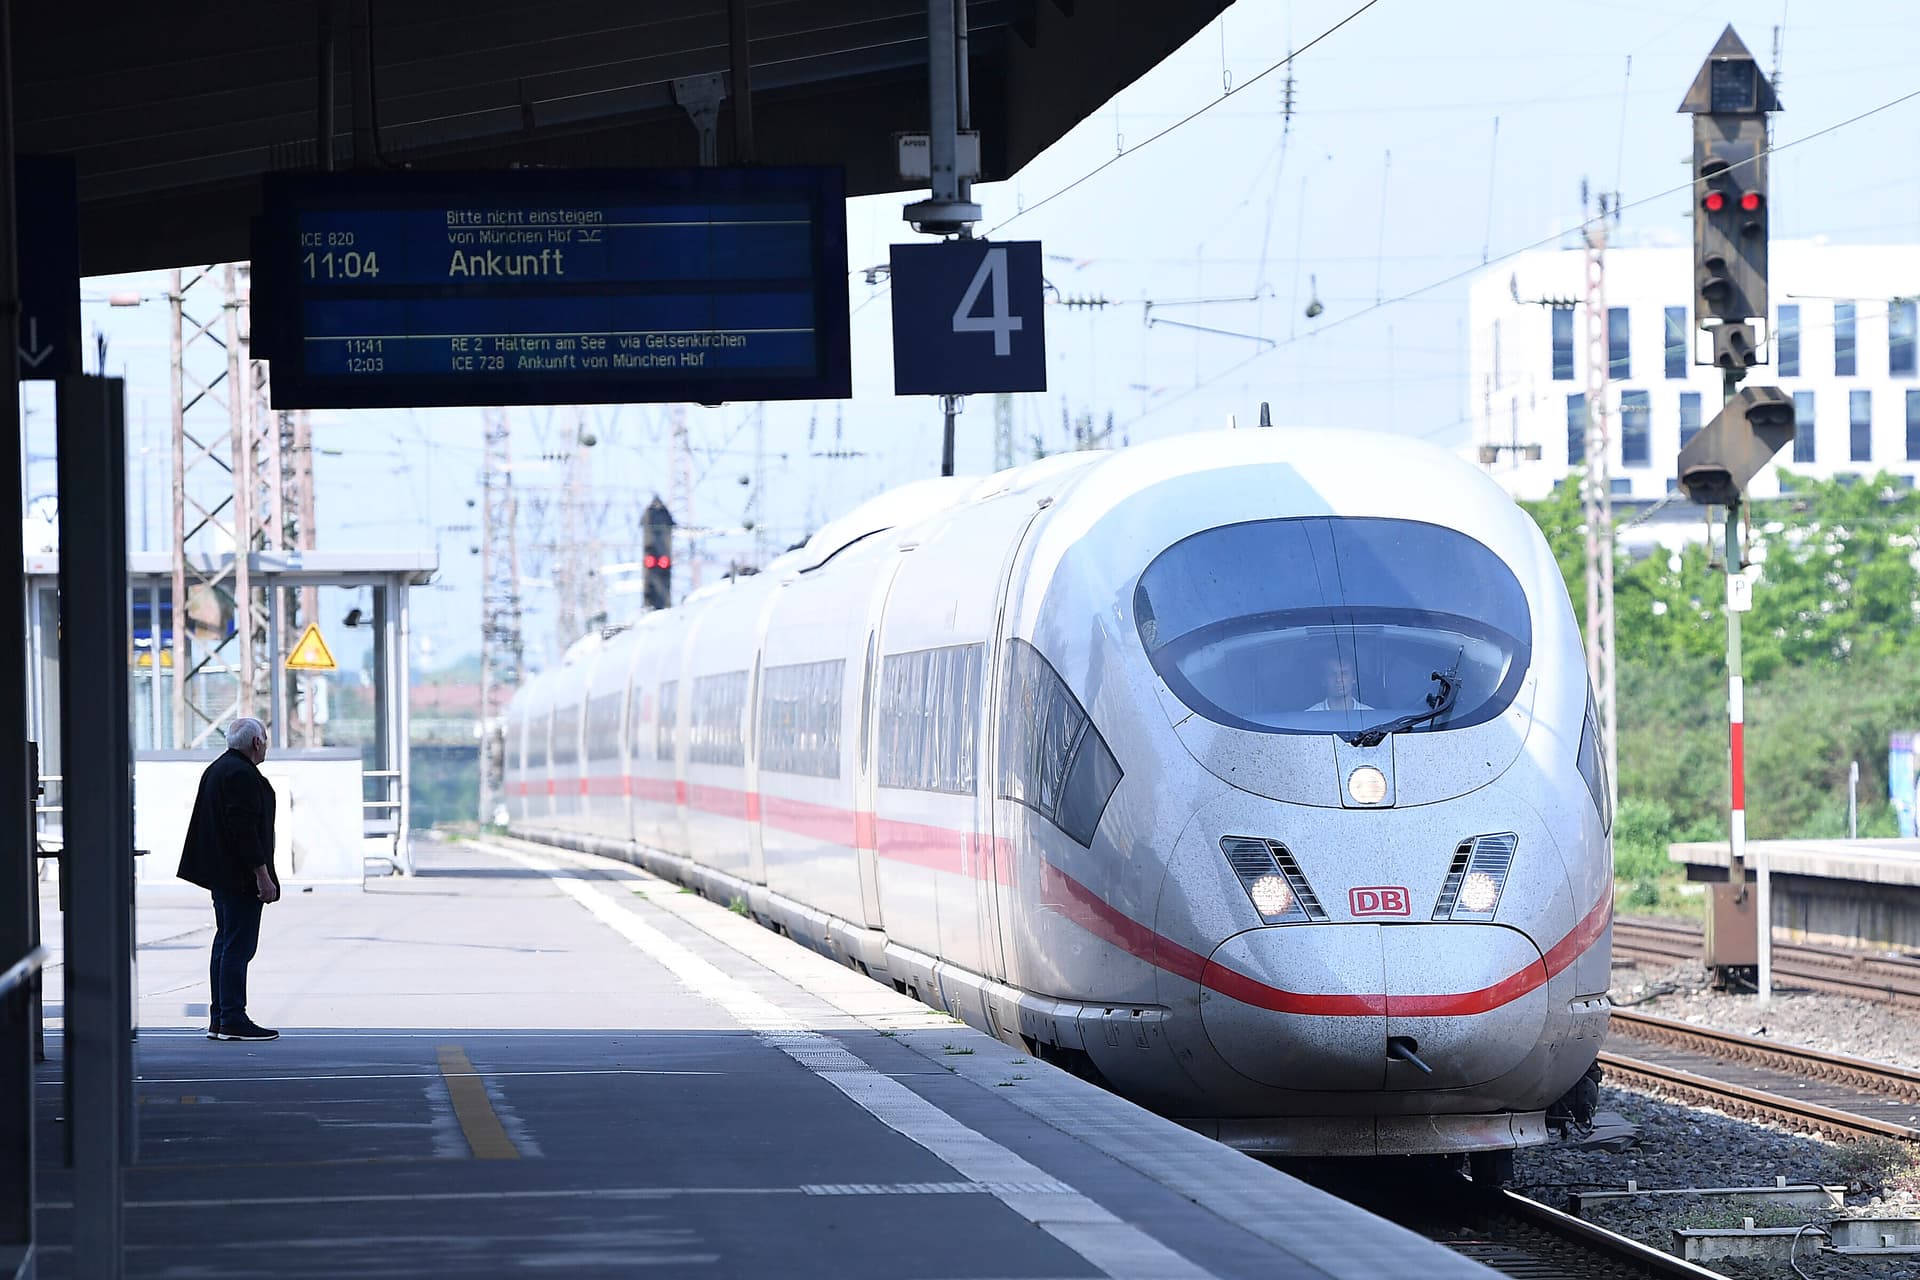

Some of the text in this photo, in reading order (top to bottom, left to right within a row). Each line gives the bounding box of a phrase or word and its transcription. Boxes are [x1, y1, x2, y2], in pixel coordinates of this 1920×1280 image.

[446, 210, 603, 225] Bitte nicht einsteigen
[301, 232, 355, 246] ICE 820
[448, 231, 475, 244] von
[479, 229, 543, 244] München
[303, 251, 380, 279] 11:04
[449, 248, 565, 277] Ankunft
[952, 247, 1023, 356] 4
[346, 339, 384, 353] 11:41
[451, 333, 747, 352] RE 2 Haltern am See via Gelsenkirchen
[346, 357, 384, 372] 12:03
[452, 351, 705, 370] ICE 728 Ankunft von München Hbf
[1357, 890, 1403, 911] DB
